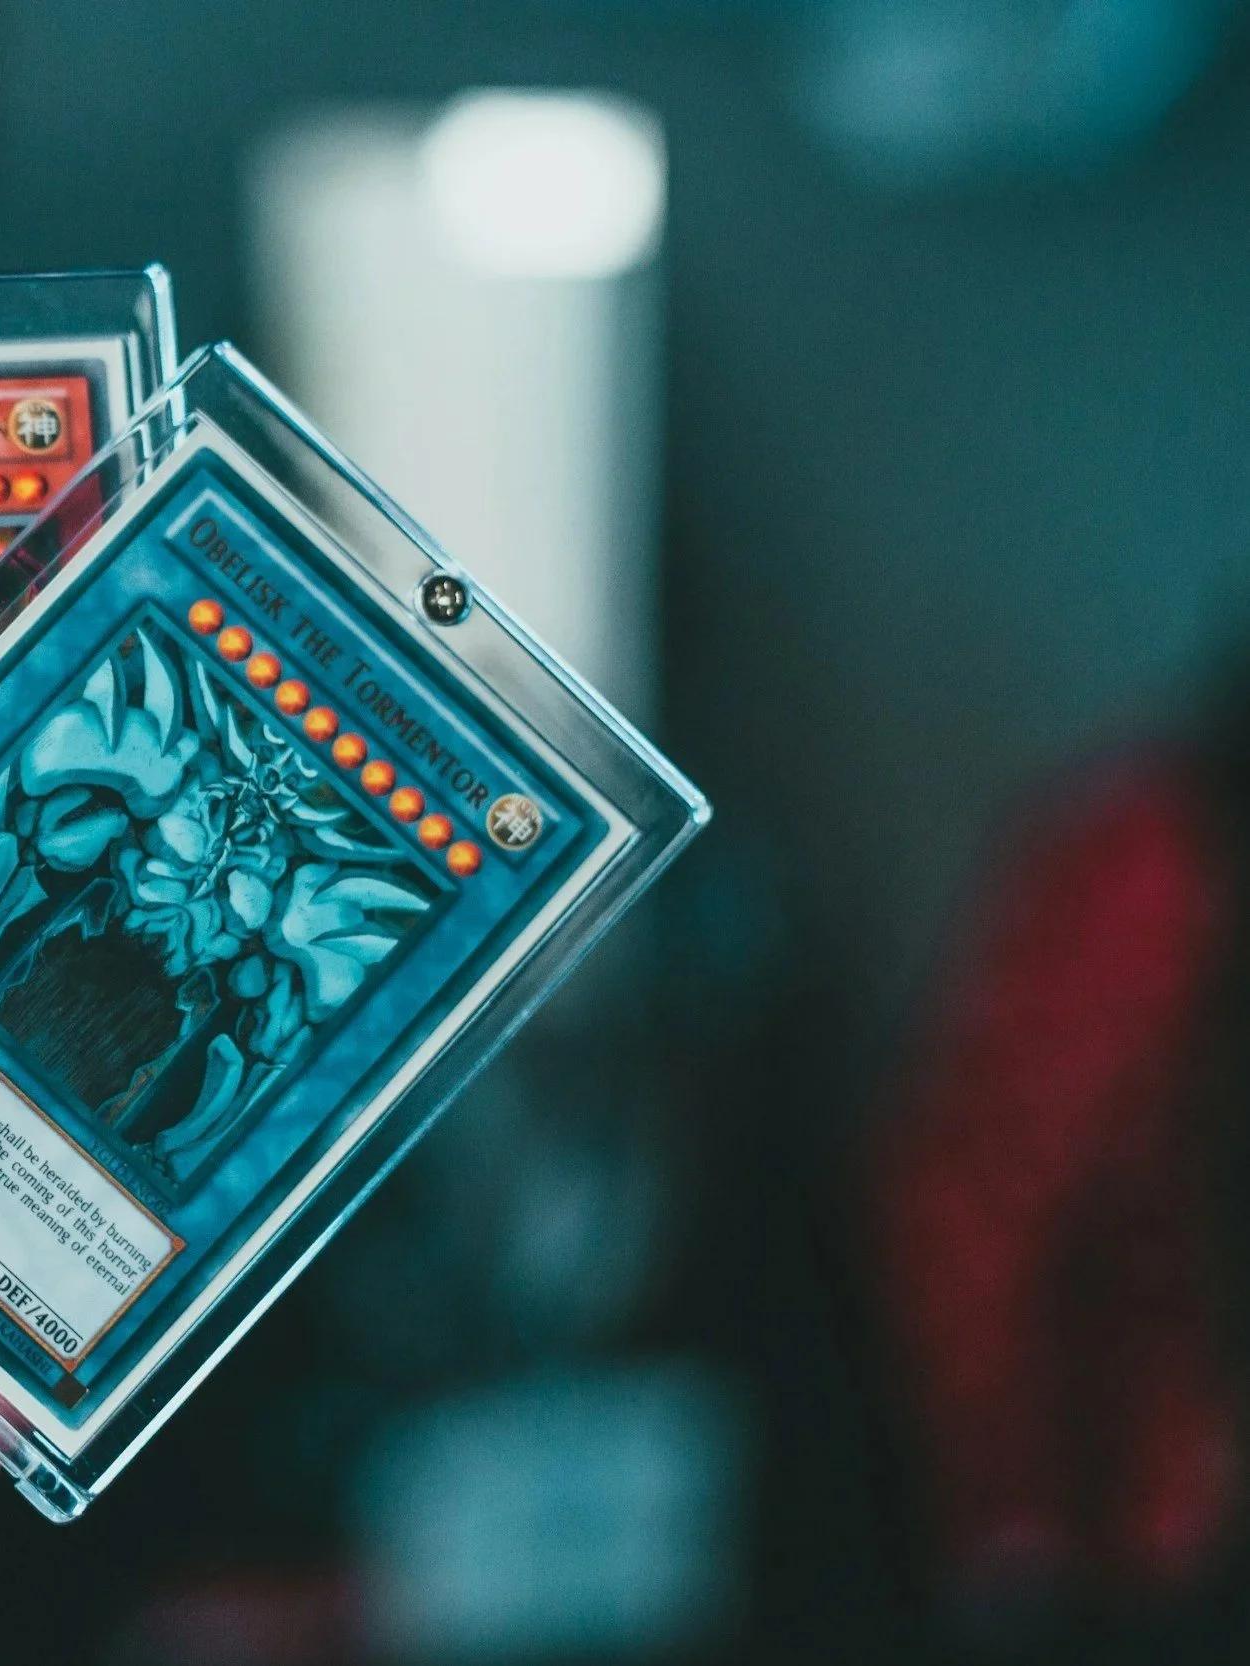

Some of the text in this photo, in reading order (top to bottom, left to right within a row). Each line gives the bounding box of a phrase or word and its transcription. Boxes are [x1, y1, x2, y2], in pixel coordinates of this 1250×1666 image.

[181, 512, 501, 810] OBELISK THE TORMENTOR
[8, 1158, 56, 1205] coming
[54, 1199, 74, 1219] of
[71, 1216, 98, 1241] this
[95, 1239, 142, 1283] horror,
[16, 1191, 72, 1244] meaning
[69, 1236, 89, 1256] of
[84, 1251, 130, 1296] eternal
[21, 1144, 43, 1165] be
[37, 1159, 93, 1213] heralded
[86, 1207, 109, 1230] by
[102, 1222, 155, 1272] burning
